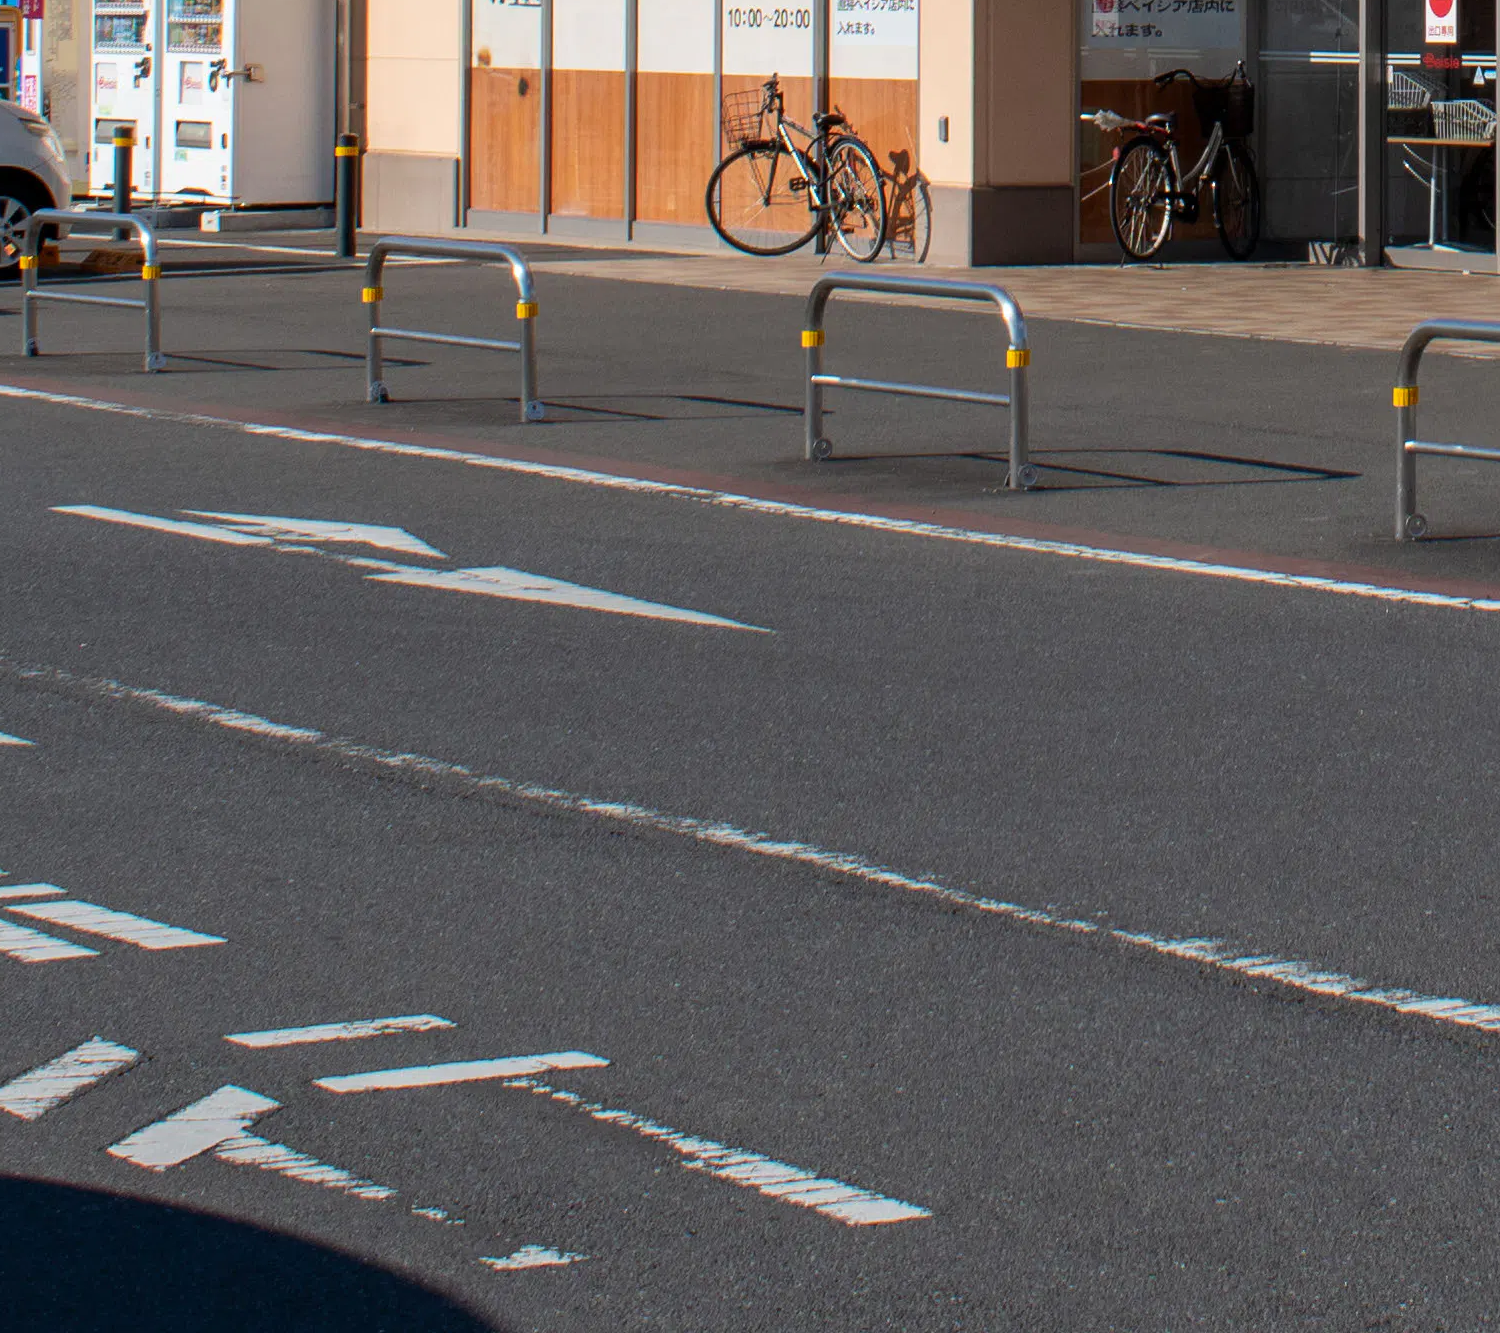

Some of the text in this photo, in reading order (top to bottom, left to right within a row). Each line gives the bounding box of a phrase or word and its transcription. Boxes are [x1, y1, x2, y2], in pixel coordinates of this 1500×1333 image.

[837, 20, 876, 36] 入れます。
[1428, 25, 1454, 37] 出口専用
[1422, 52, 1460, 70] Beisia
